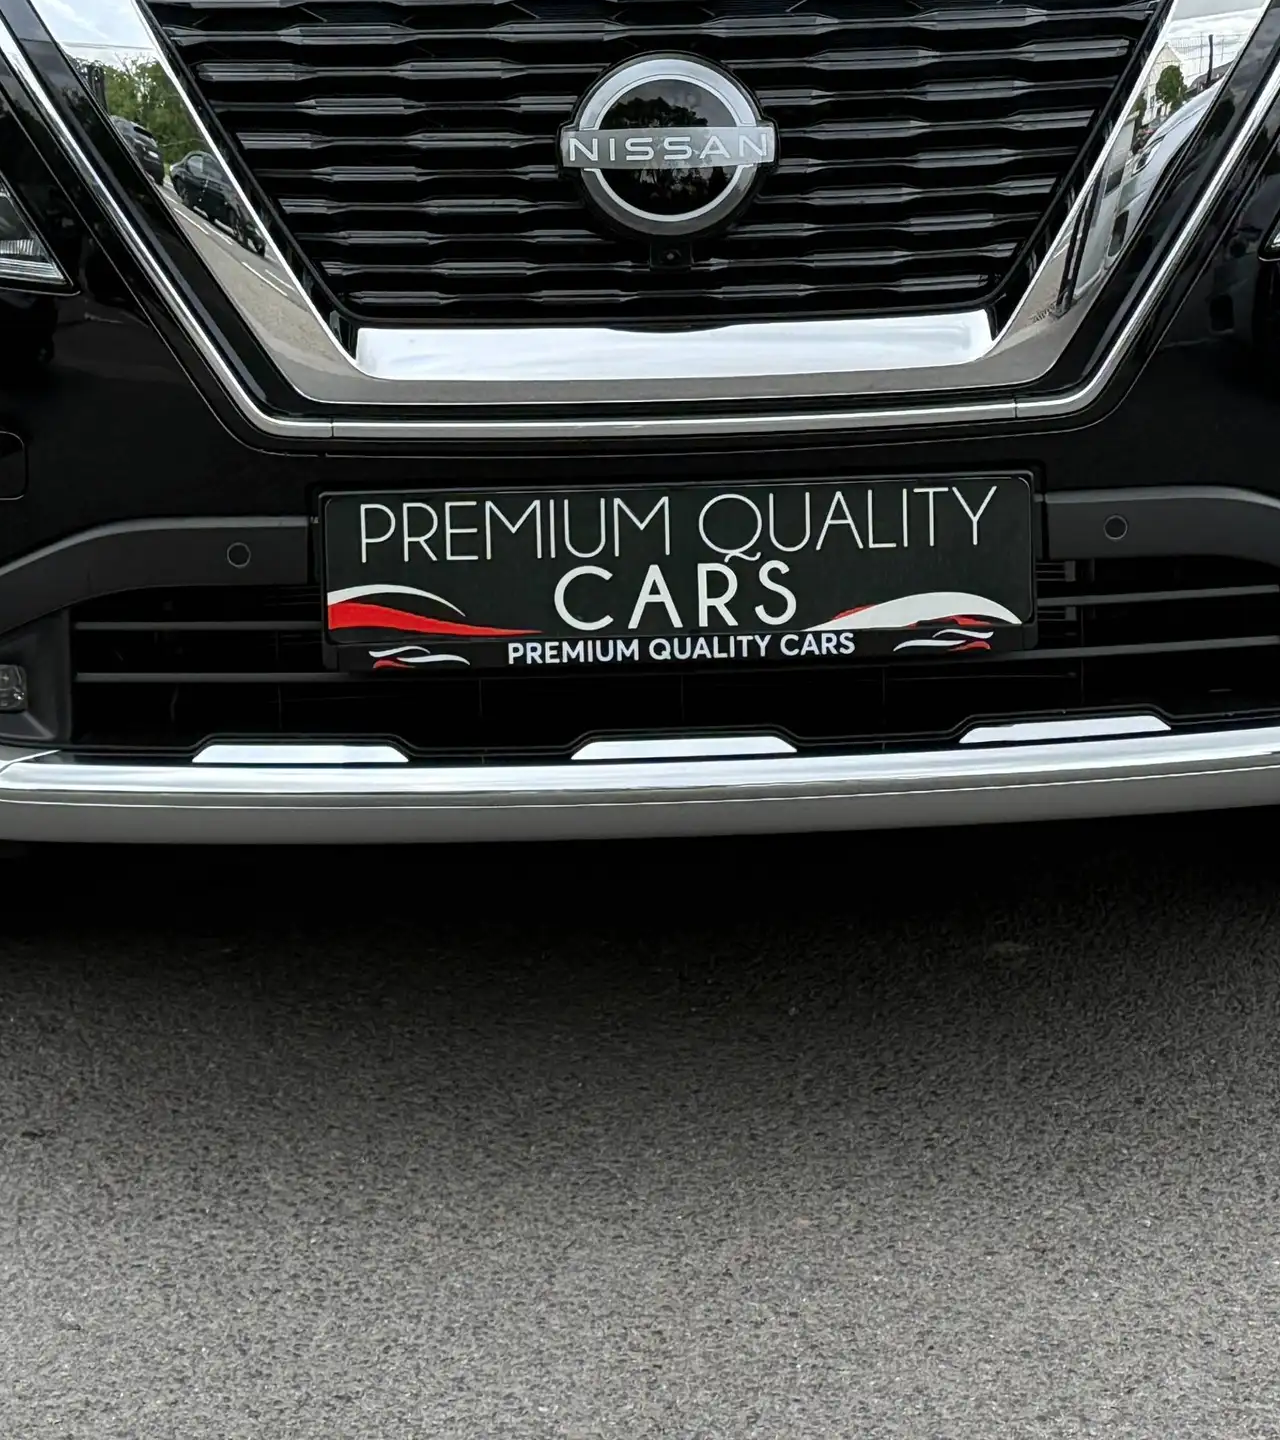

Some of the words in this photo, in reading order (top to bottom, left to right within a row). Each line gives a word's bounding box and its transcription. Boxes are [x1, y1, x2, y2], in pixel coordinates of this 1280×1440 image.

[570, 134, 768, 162] NISSAN
[360, 496, 671, 564] PREMIUM
[698, 485, 998, 563] QUALITY
[553, 559, 797, 631] CARS
[507, 638, 639, 665] PREMIUM
[648, 634, 772, 661] QUALITY
[780, 632, 856, 656] CARS
